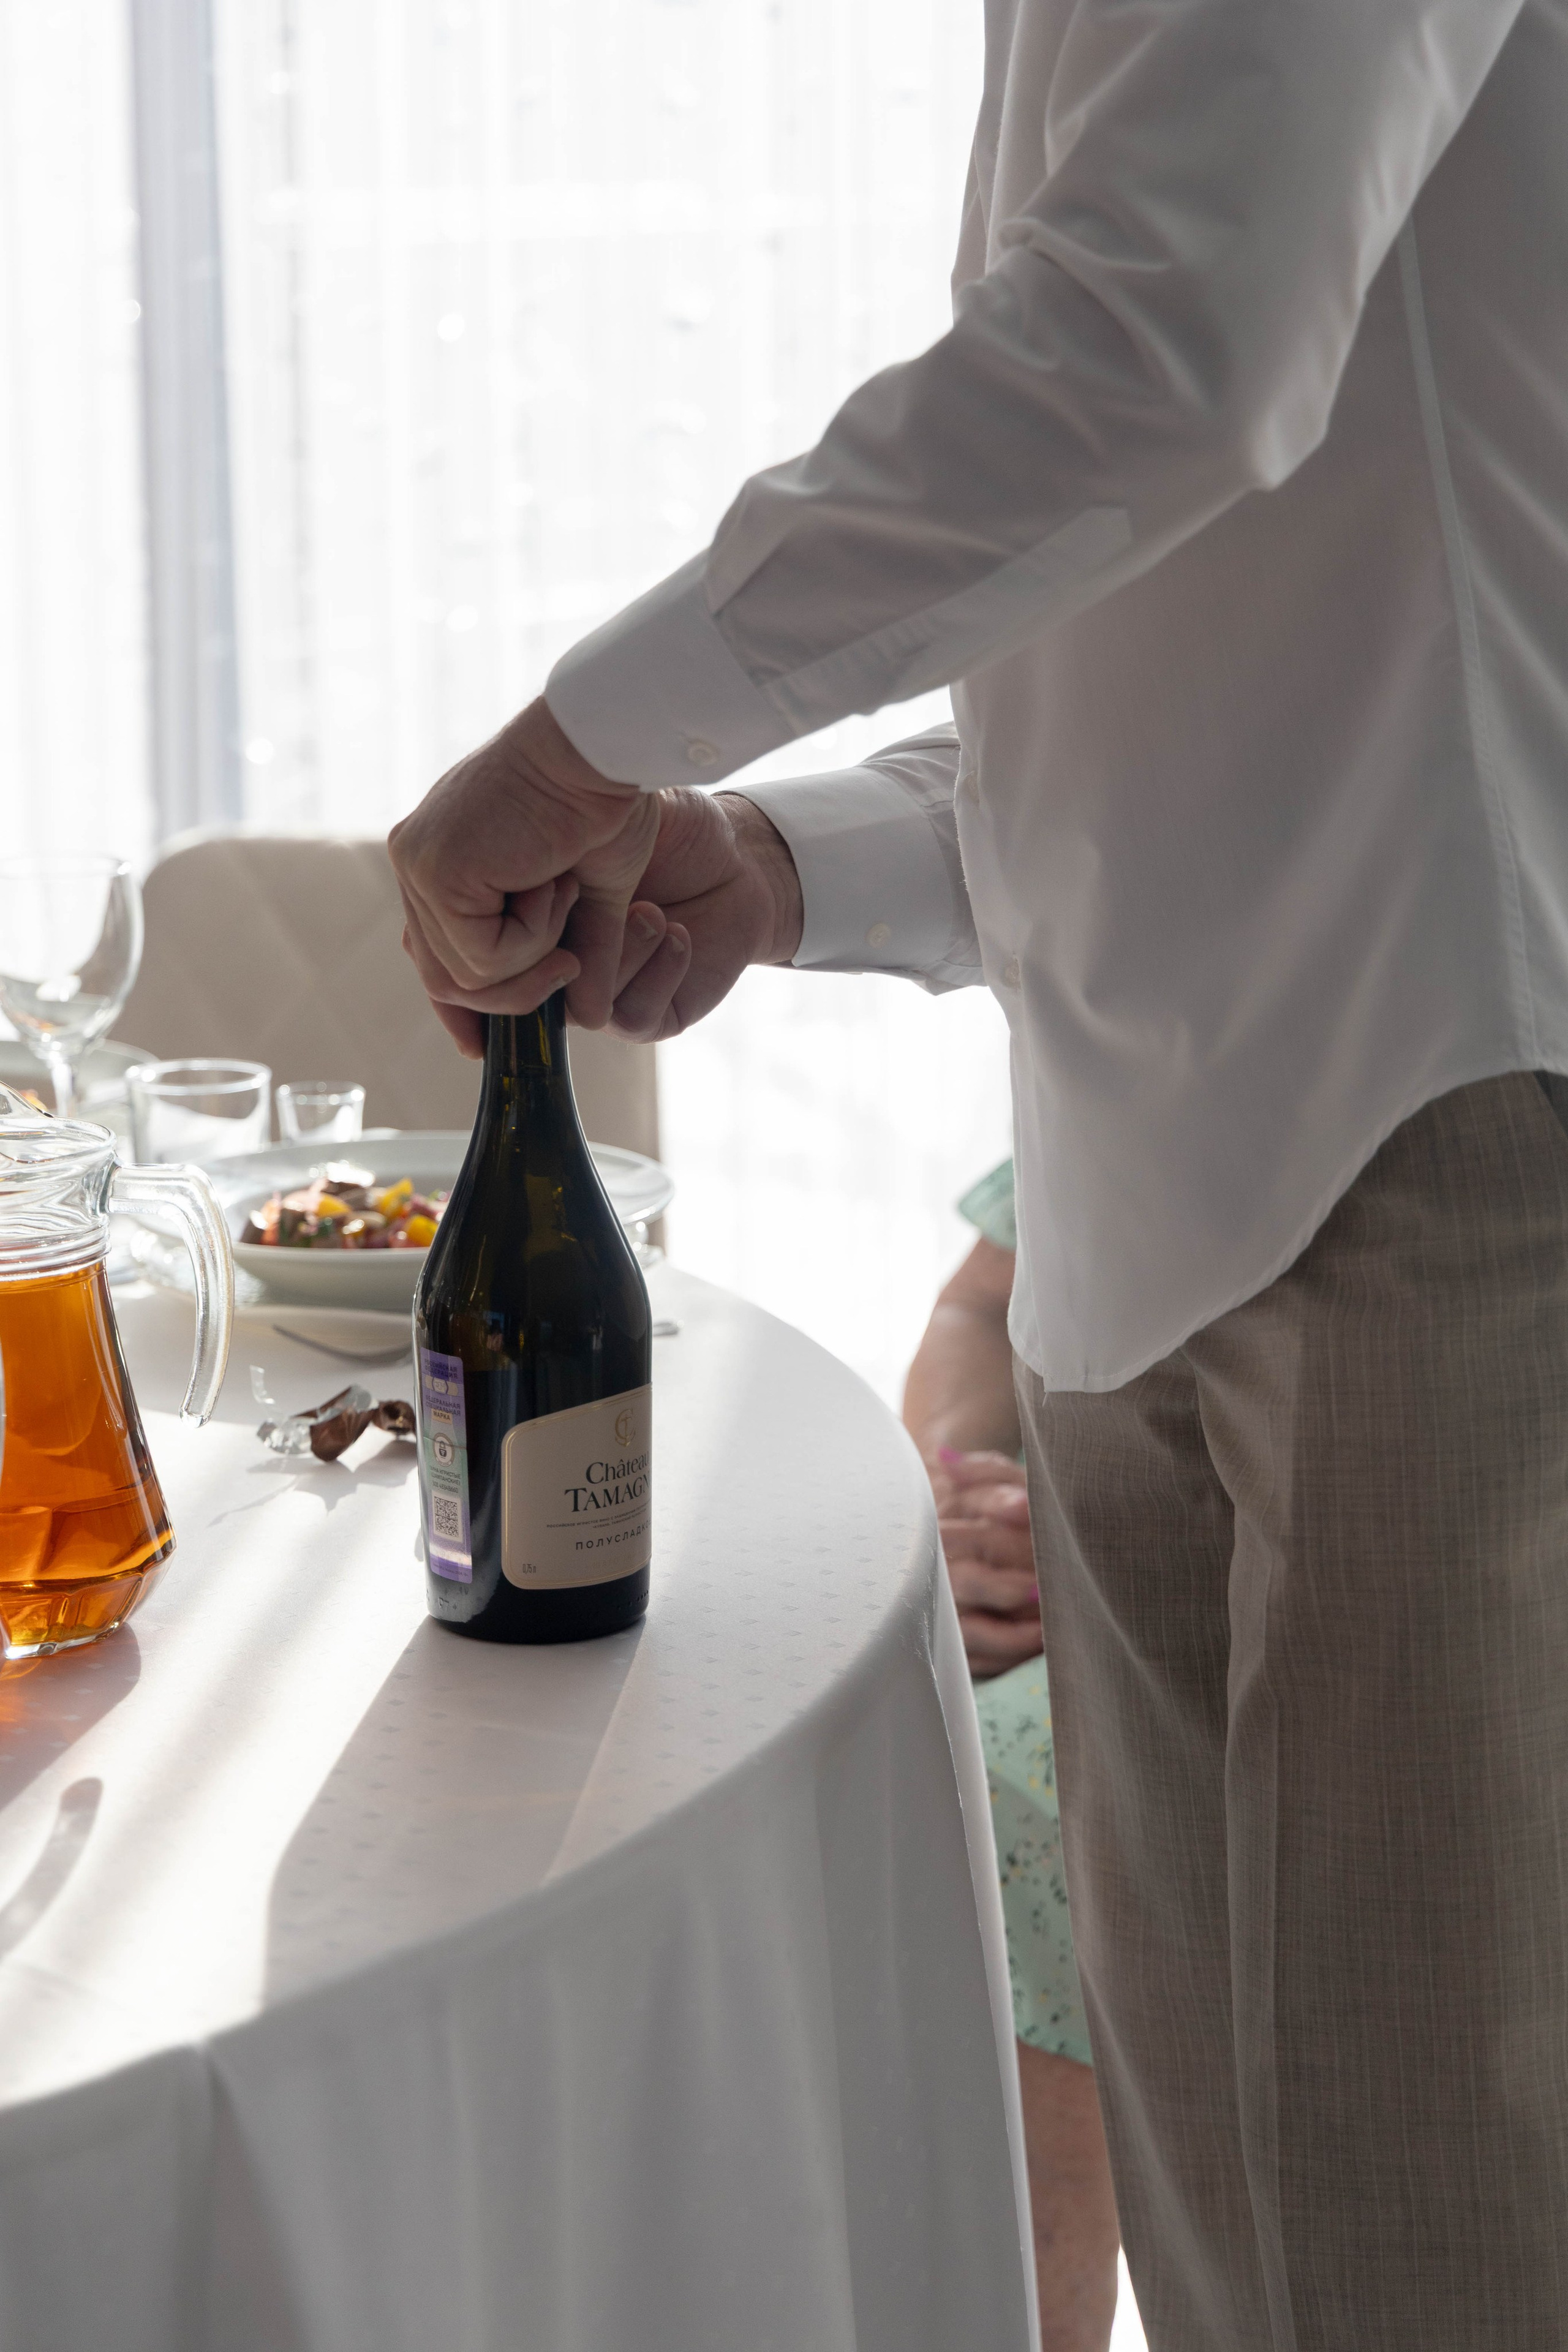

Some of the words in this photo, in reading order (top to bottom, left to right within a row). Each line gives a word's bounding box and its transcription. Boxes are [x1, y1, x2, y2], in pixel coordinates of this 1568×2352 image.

[433, 1411, 451, 1420] МАРКА
[586, 1451, 649, 1484] Château
[564, 1471, 651, 1513] TAMAGN
